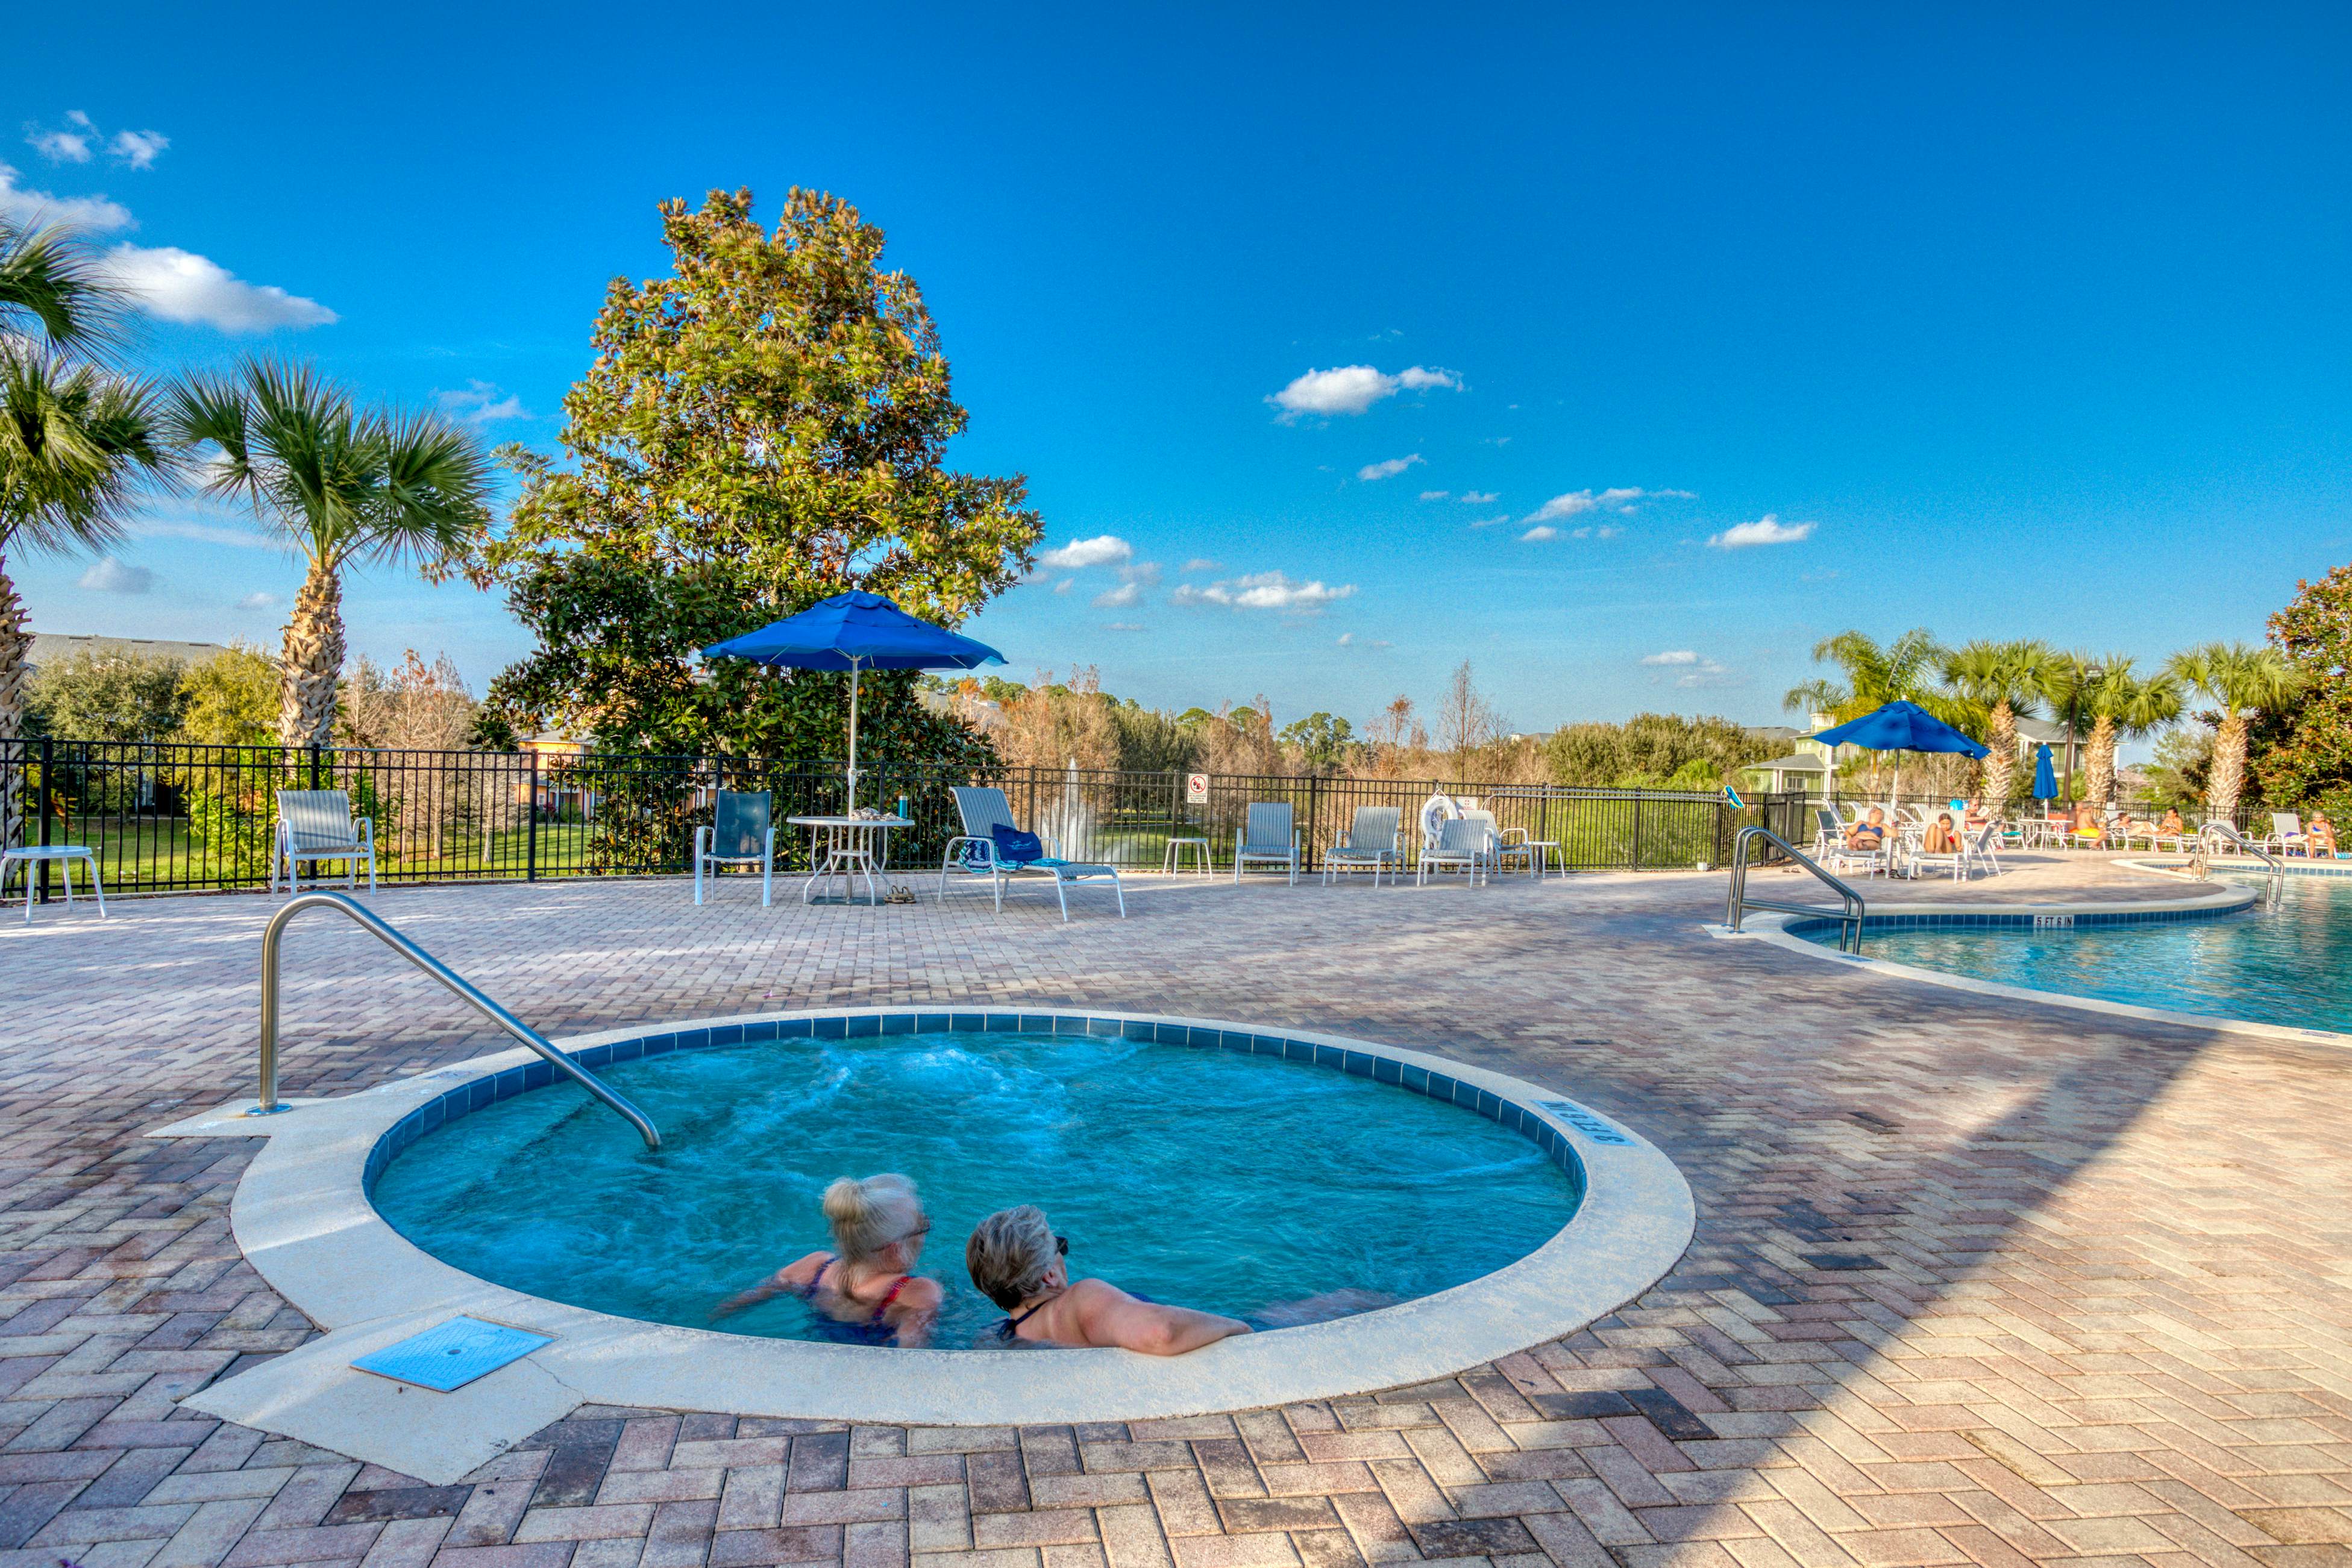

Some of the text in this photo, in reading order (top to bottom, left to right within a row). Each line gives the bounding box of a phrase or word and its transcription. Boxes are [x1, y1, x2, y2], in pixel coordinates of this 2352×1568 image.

[2037, 917, 2072, 926] 5 FT 6 IN
[1540, 1102, 1578, 1112] IN
[1571, 1120, 1613, 1133] FT
